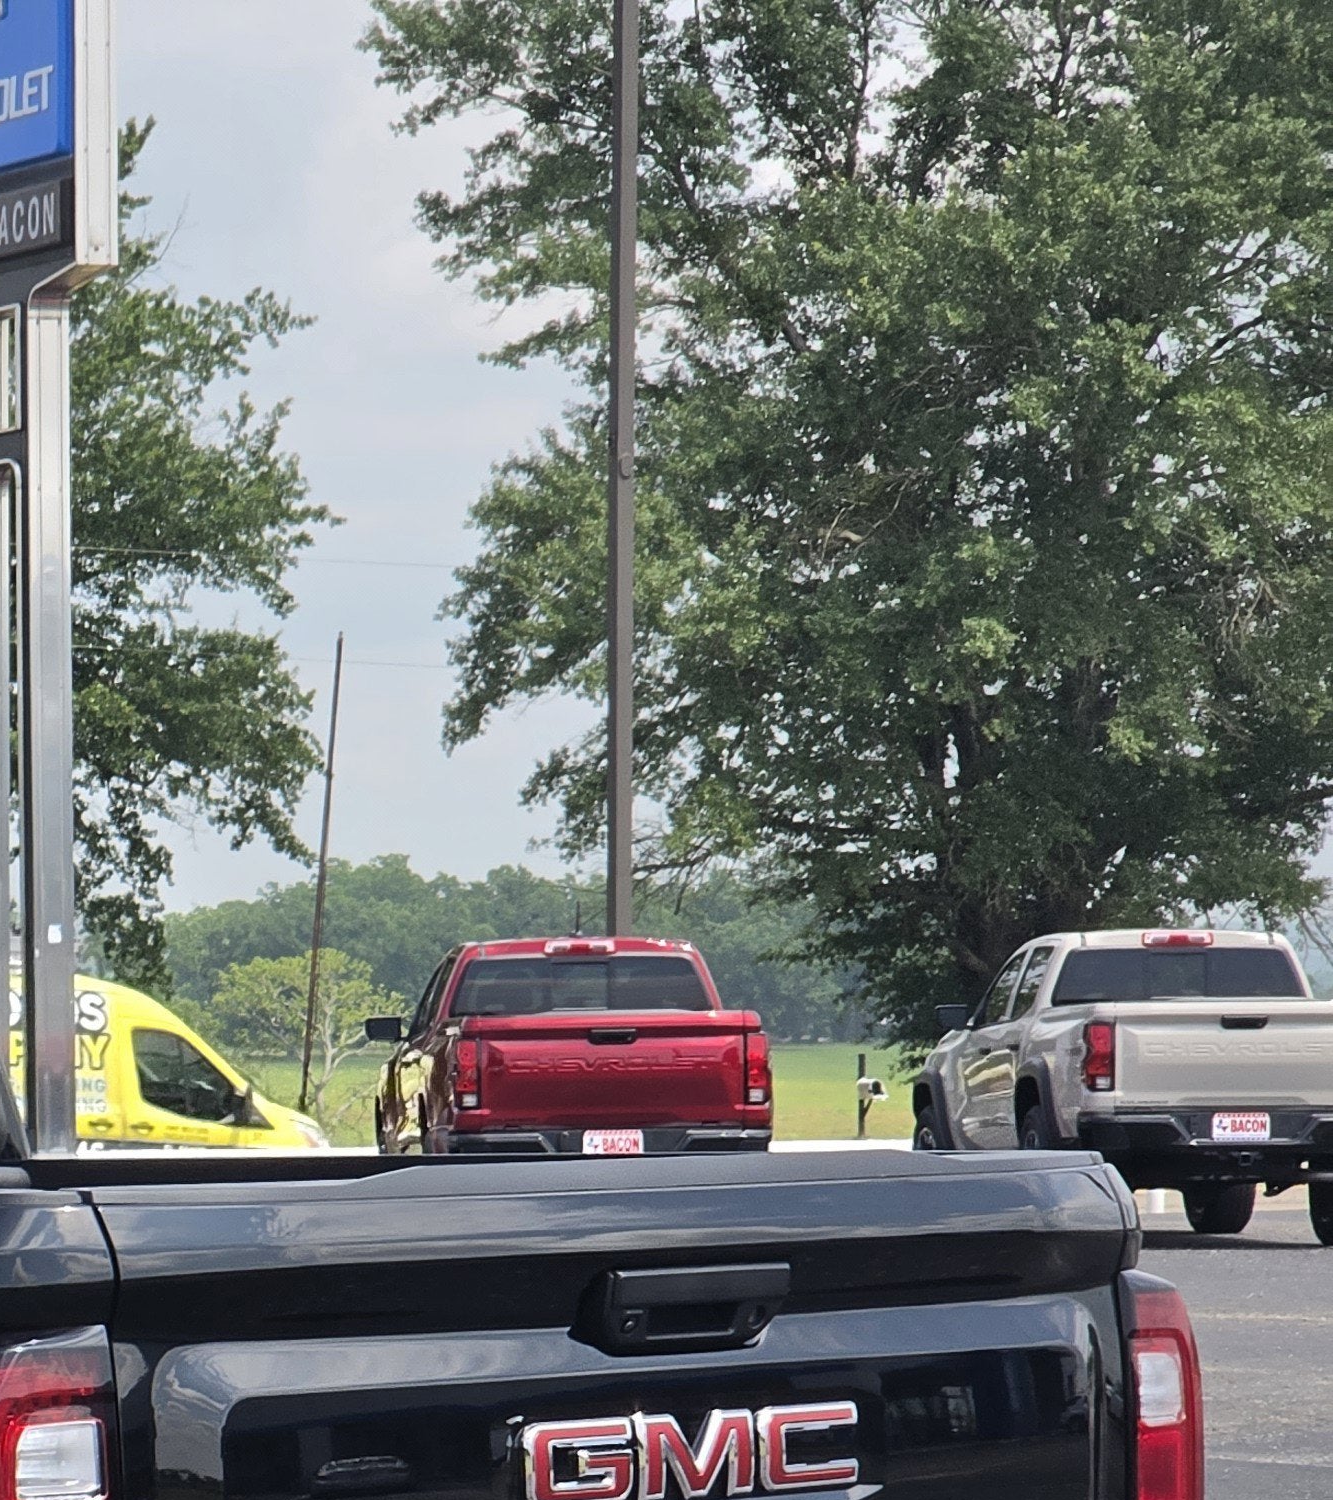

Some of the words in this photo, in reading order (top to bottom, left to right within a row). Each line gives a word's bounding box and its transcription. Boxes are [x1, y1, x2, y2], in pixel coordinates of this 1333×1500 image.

[506, 1055, 719, 1074] CHEVROLET
[1230, 1119, 1267, 1133] BACON
[602, 1137, 640, 1152] BACON
